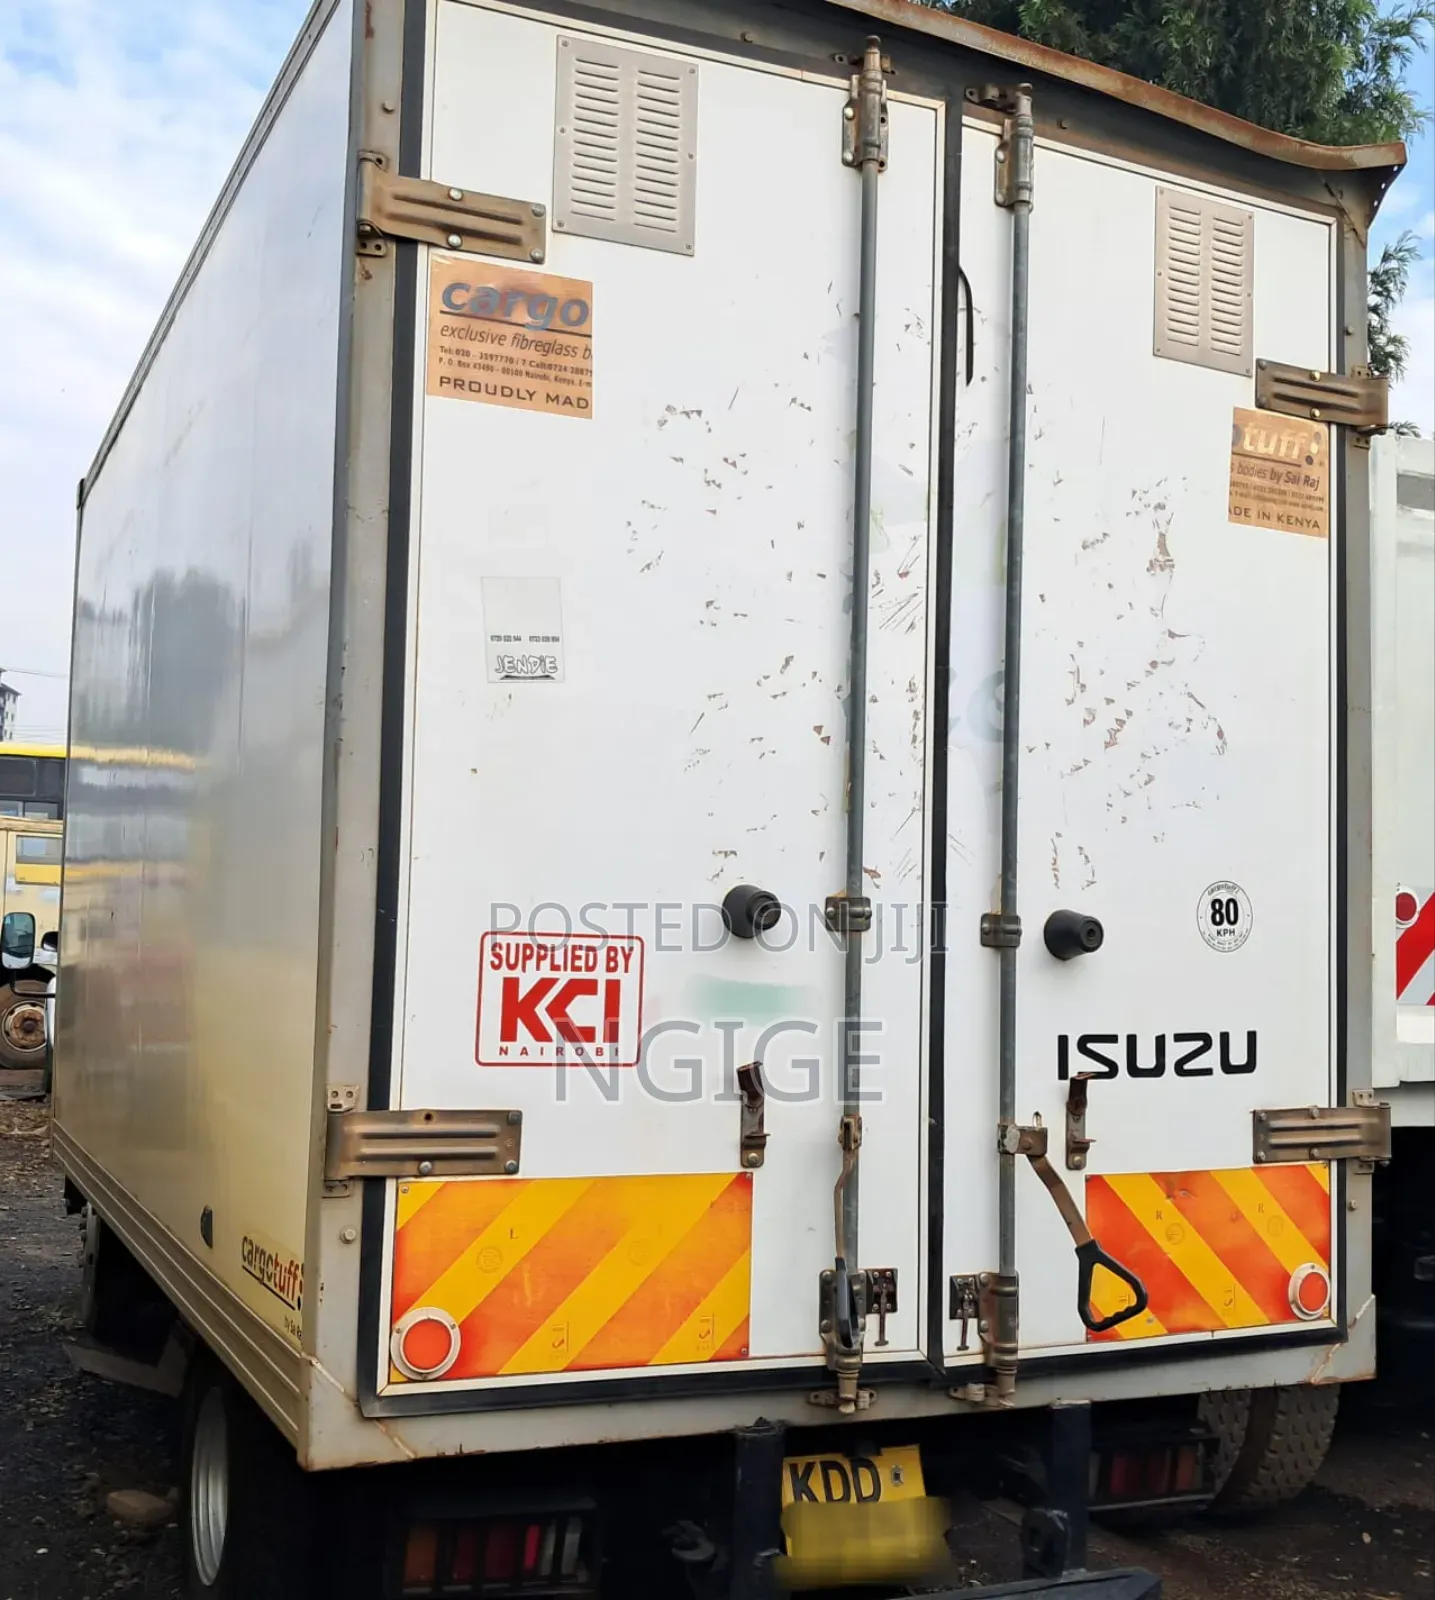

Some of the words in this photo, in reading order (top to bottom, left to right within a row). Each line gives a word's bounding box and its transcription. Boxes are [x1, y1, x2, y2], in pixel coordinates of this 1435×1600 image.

[442, 282, 589, 331] cargo
[440, 324, 507, 346] exclusive
[510, 332, 579, 358] fibreglass
[440, 375, 537, 402] PROUDLY
[545, 392, 589, 410] MAD
[1237, 461, 1267, 478] bodies
[1269, 466, 1282, 485] by
[1284, 470, 1300, 485] Sai
[1303, 474, 1320, 492] Raj
[1257, 510, 1271, 522] IN
[1277, 513, 1320, 530] KENYA
[1210, 897, 1239, 927] 80
[1216, 928, 1236, 937] KPH
[489, 942, 598, 973] SUPPLIED
[605, 945, 634, 973] BY
[500, 976, 621, 1043] KCI
[499, 1046, 619, 1057] NAIROBI
[1057, 1030, 1257, 1080] ISUZU
[242, 1235, 299, 1303] cargotuff
[789, 1457, 882, 1504] KDD
